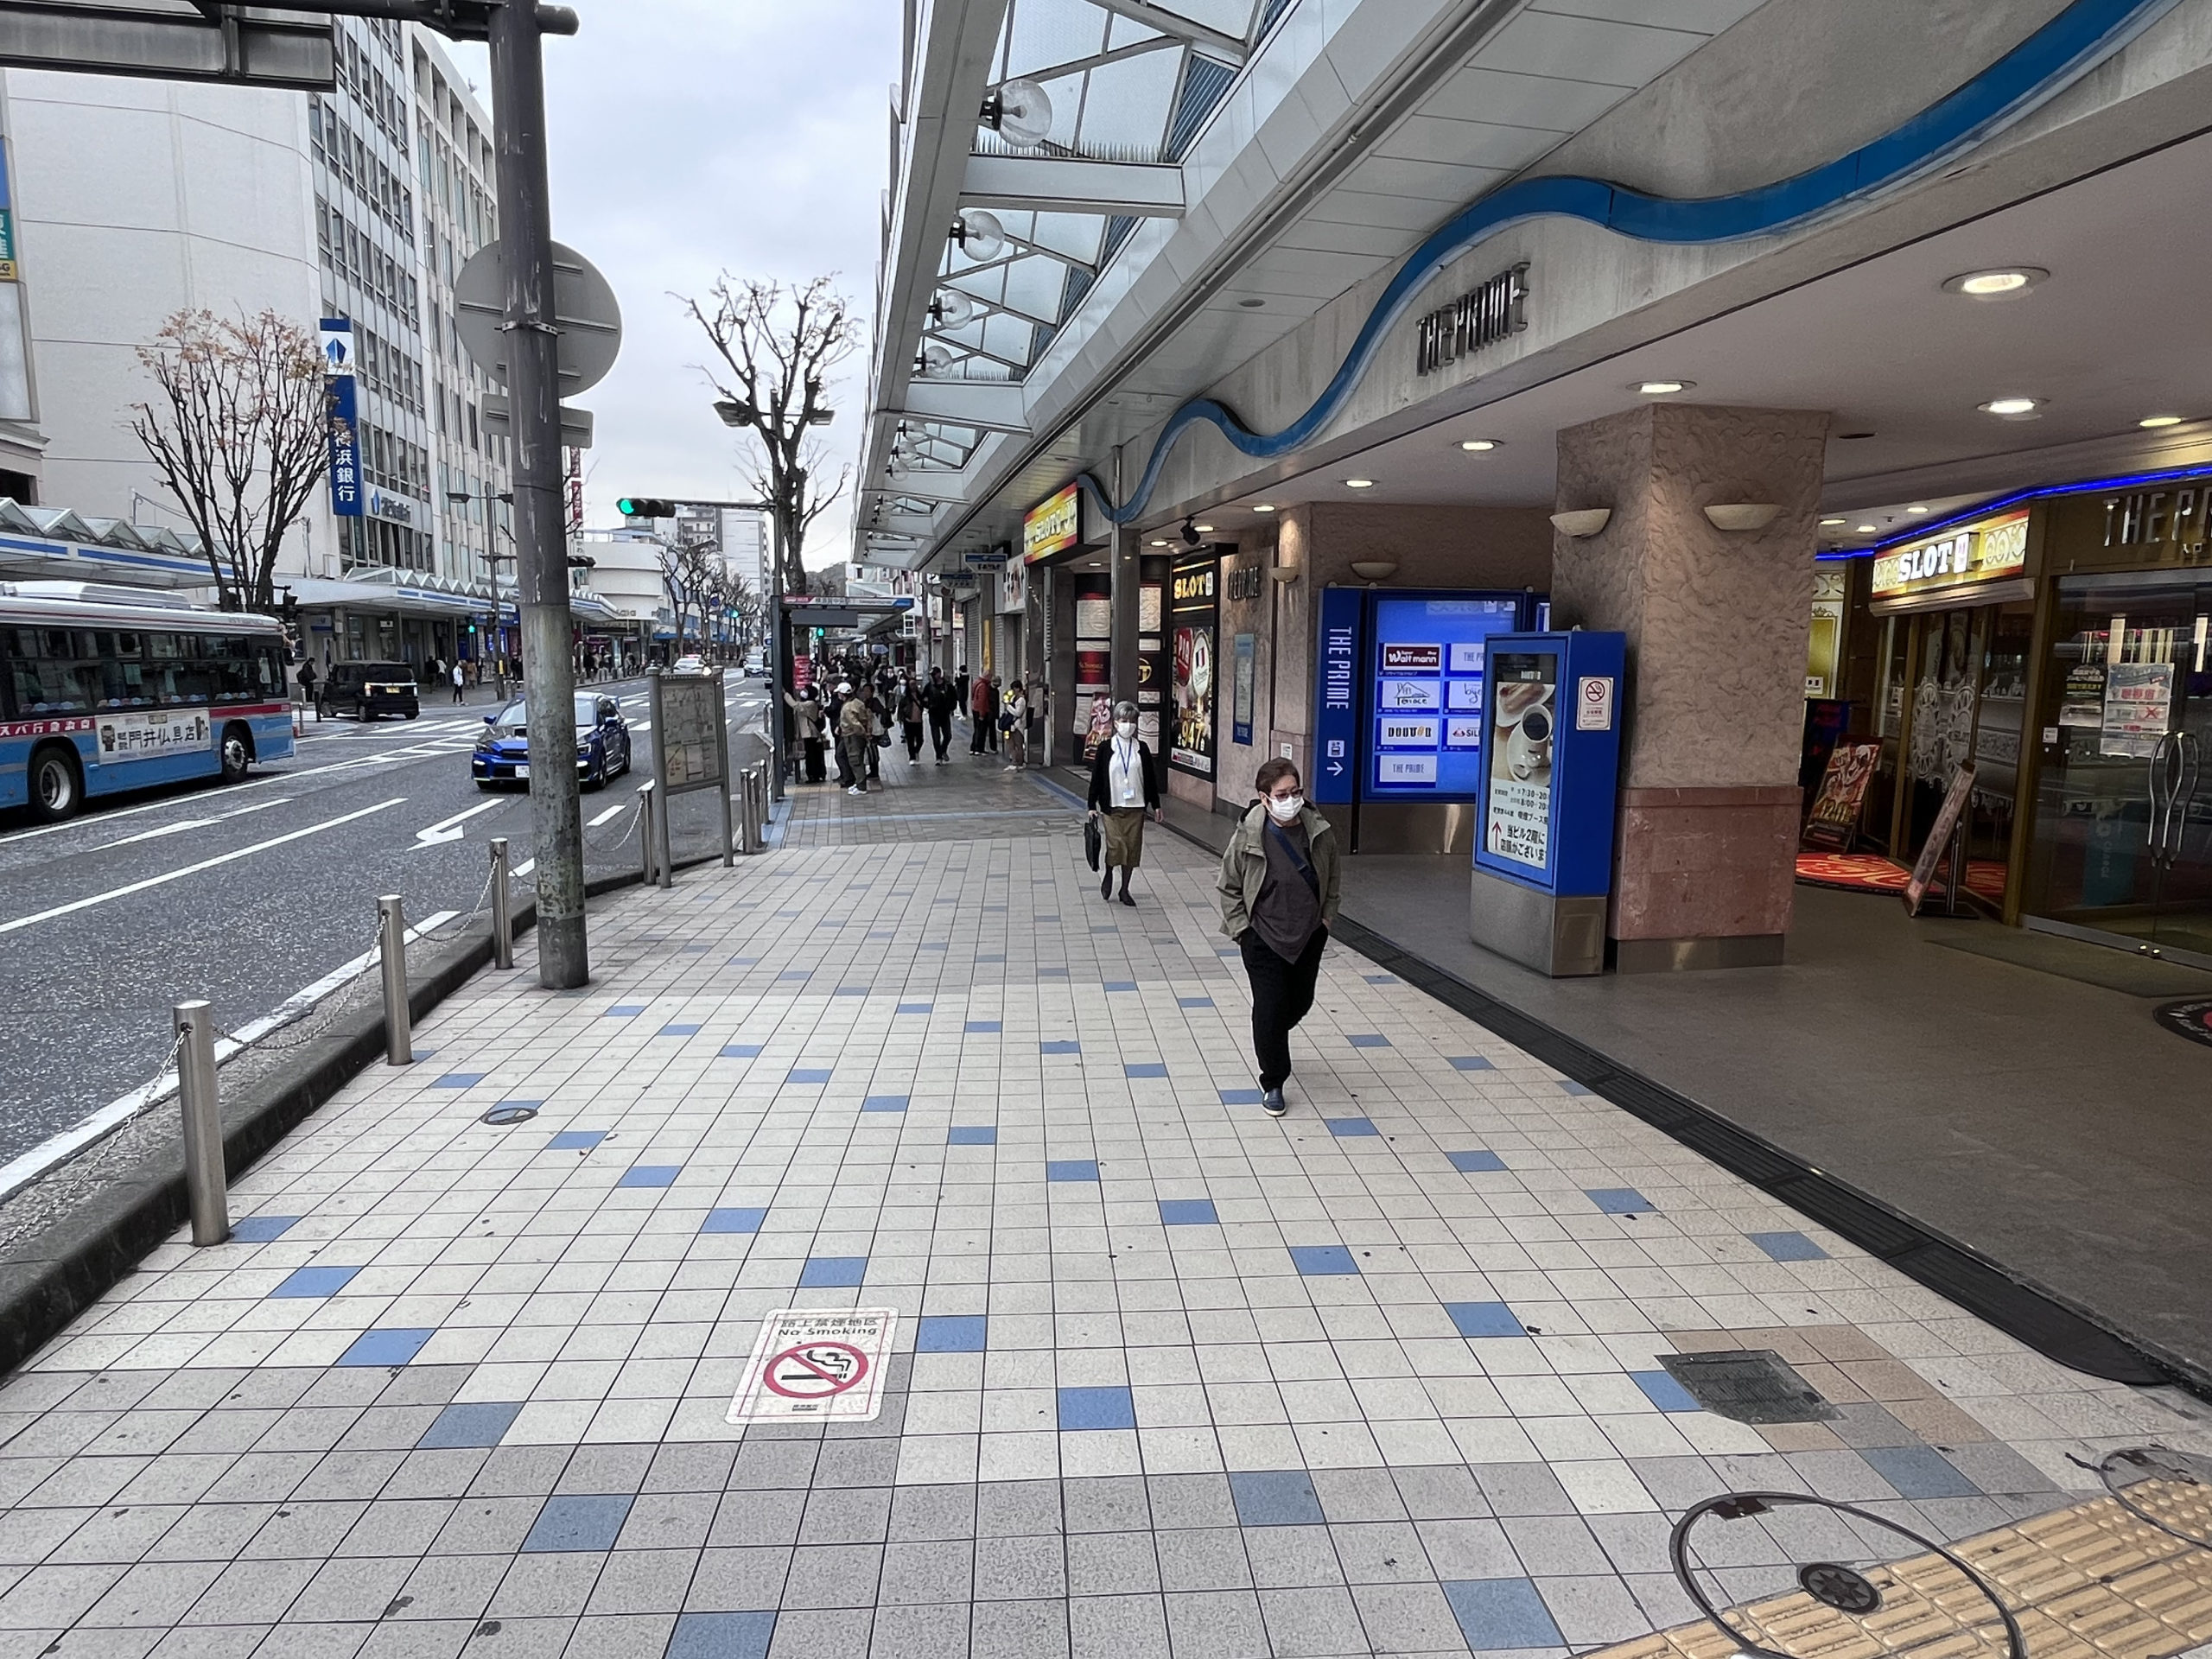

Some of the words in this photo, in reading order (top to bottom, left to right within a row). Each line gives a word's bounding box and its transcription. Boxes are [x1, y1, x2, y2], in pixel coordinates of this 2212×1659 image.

[1415, 303, 1458, 377] THE
[1455, 261, 1531, 359] PRIME
[2102, 492, 2166, 548] THE
[1897, 539, 1954, 583] SLOT
[1174, 574, 1205, 600] SLOT
[1328, 626, 1352, 655] THE
[1326, 660, 1351, 709] PRIME
[1393, 764, 1403, 773] THE
[808, 1326, 877, 1336] Smoking
